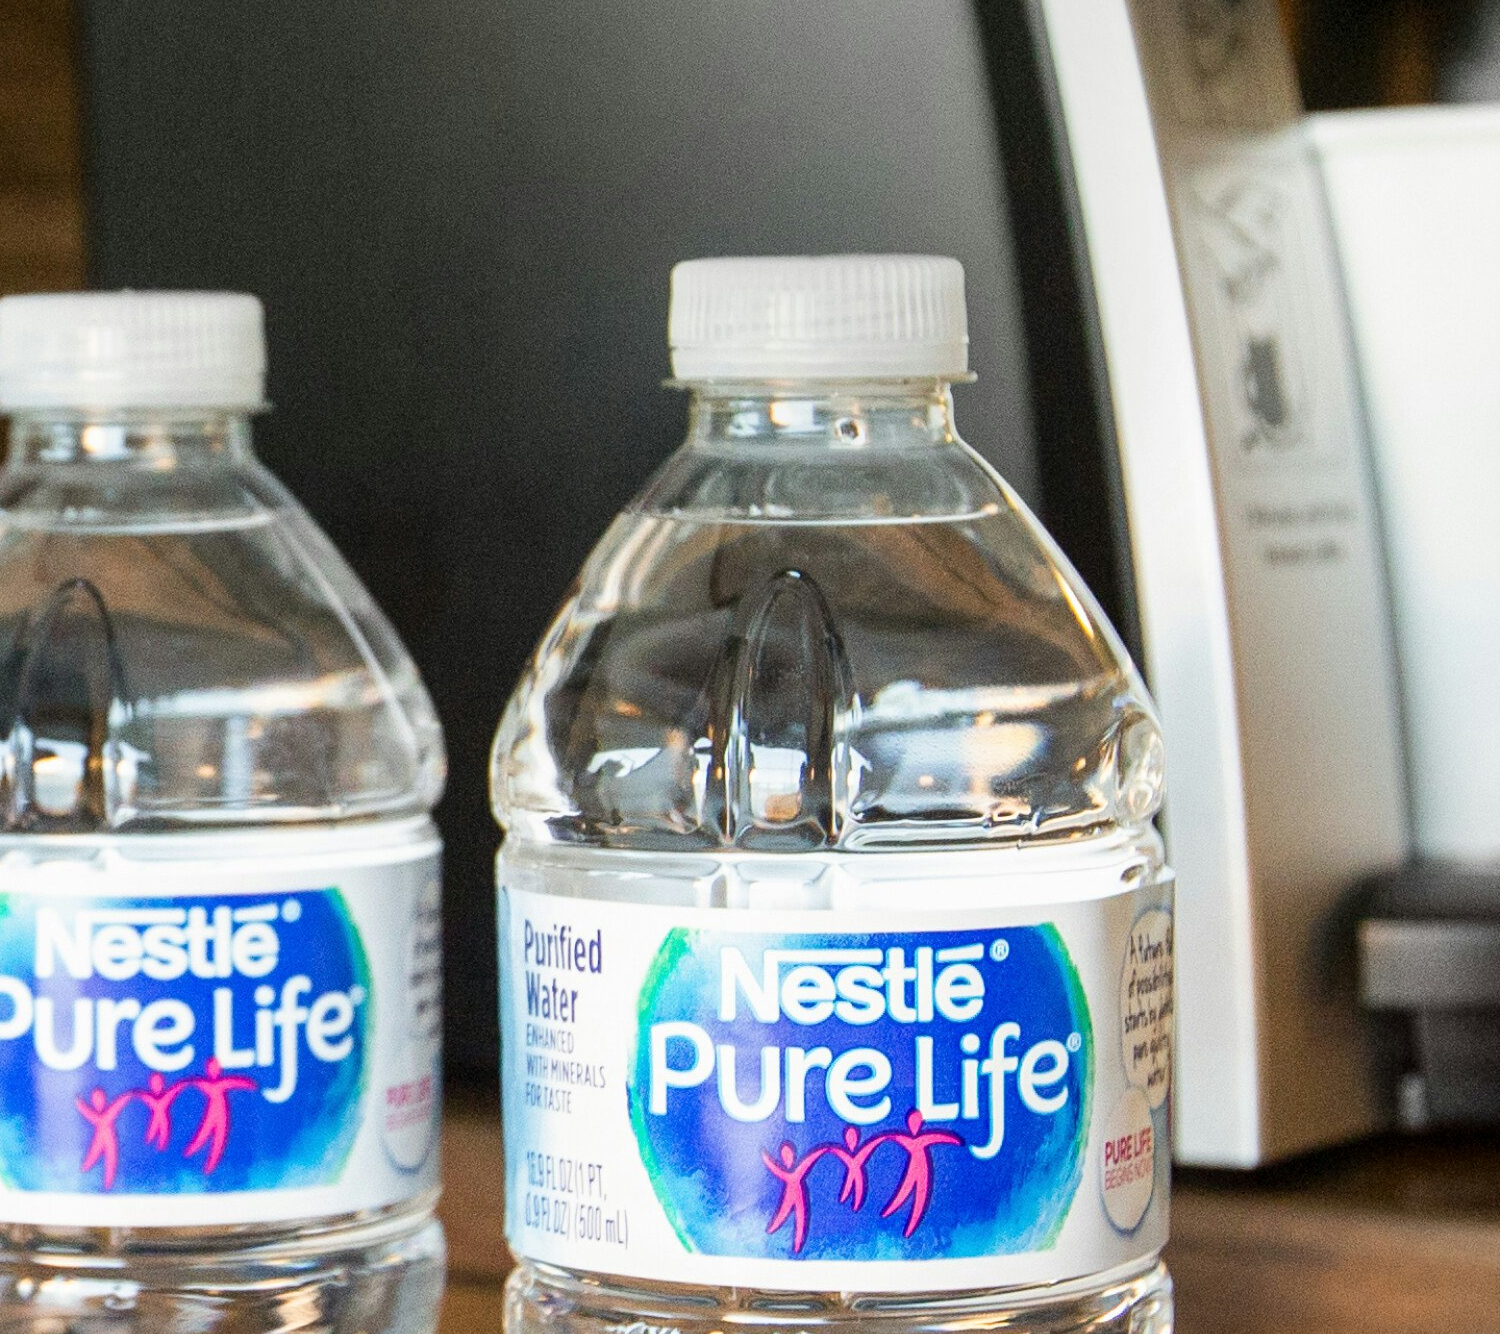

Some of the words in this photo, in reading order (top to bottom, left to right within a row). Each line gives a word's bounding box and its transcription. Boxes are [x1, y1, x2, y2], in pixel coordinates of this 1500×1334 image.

[523, 918, 603, 975] Purified
[524, 970, 579, 1024] Water
[214, 973, 356, 1104] Life
[550, 1057, 606, 1089] MINERALS
[648, 1019, 894, 1125] Pure
[916, 1019, 1071, 1160] Life
